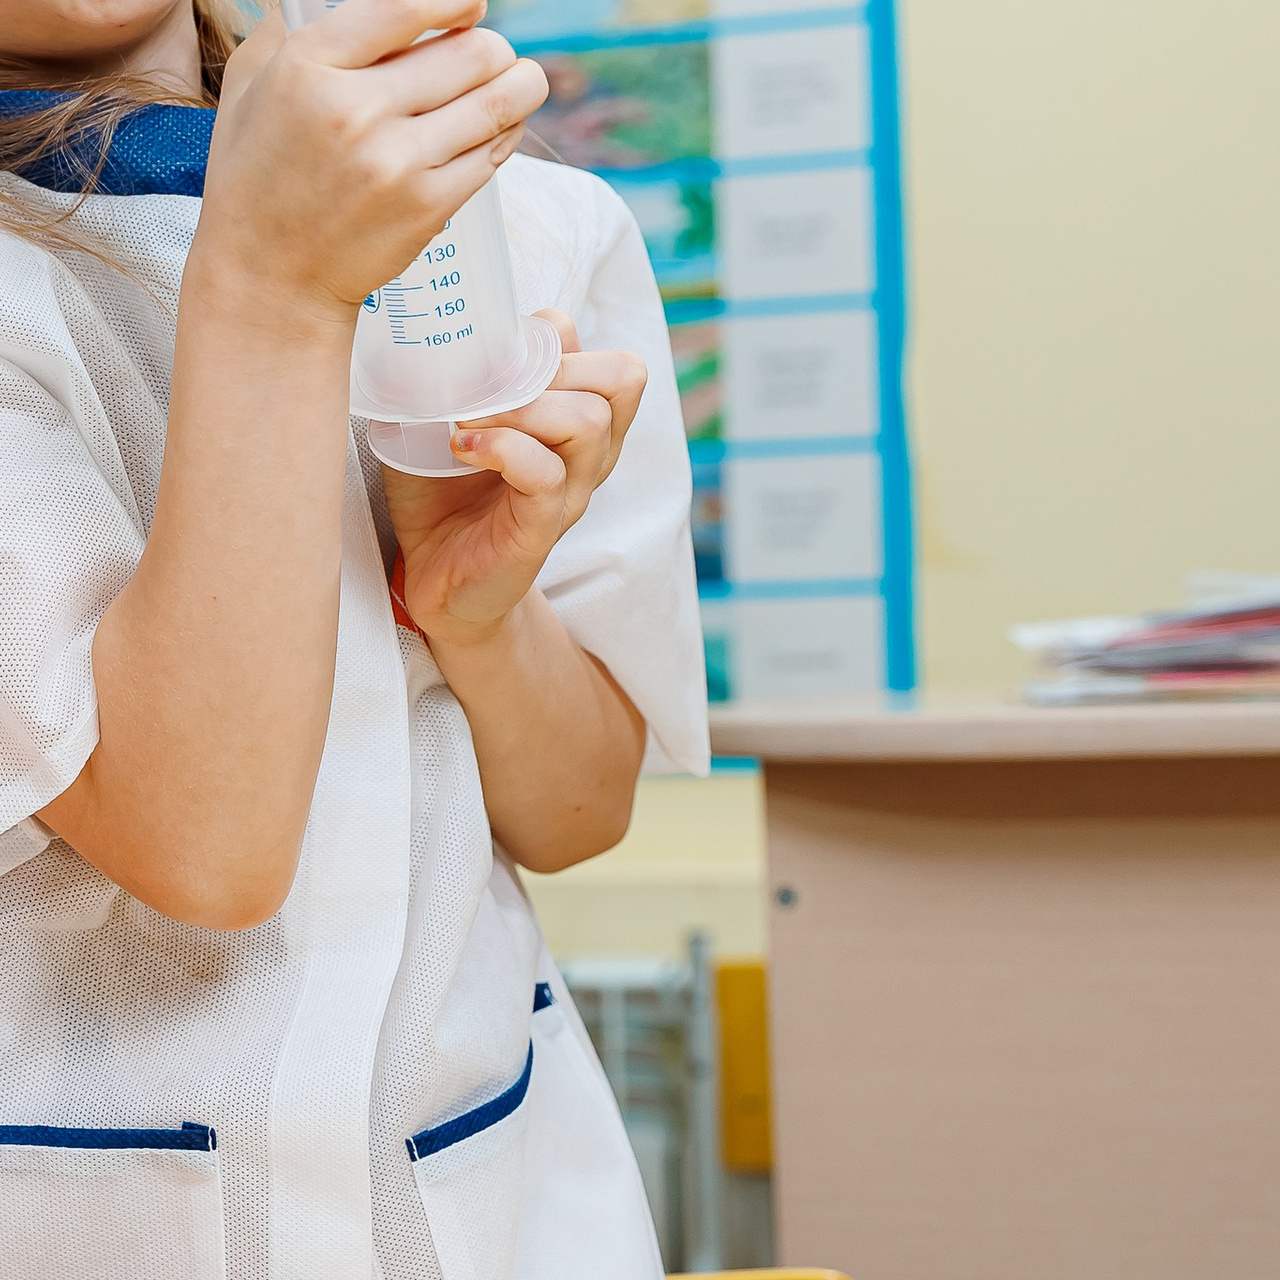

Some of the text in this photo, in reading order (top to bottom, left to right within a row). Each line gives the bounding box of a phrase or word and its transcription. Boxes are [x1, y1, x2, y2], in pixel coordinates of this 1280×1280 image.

[424, 243, 456, 264] 130
[429, 271, 461, 291] 140
[434, 298, 466, 318] 150
[424, 324, 474, 347] 160 ml
